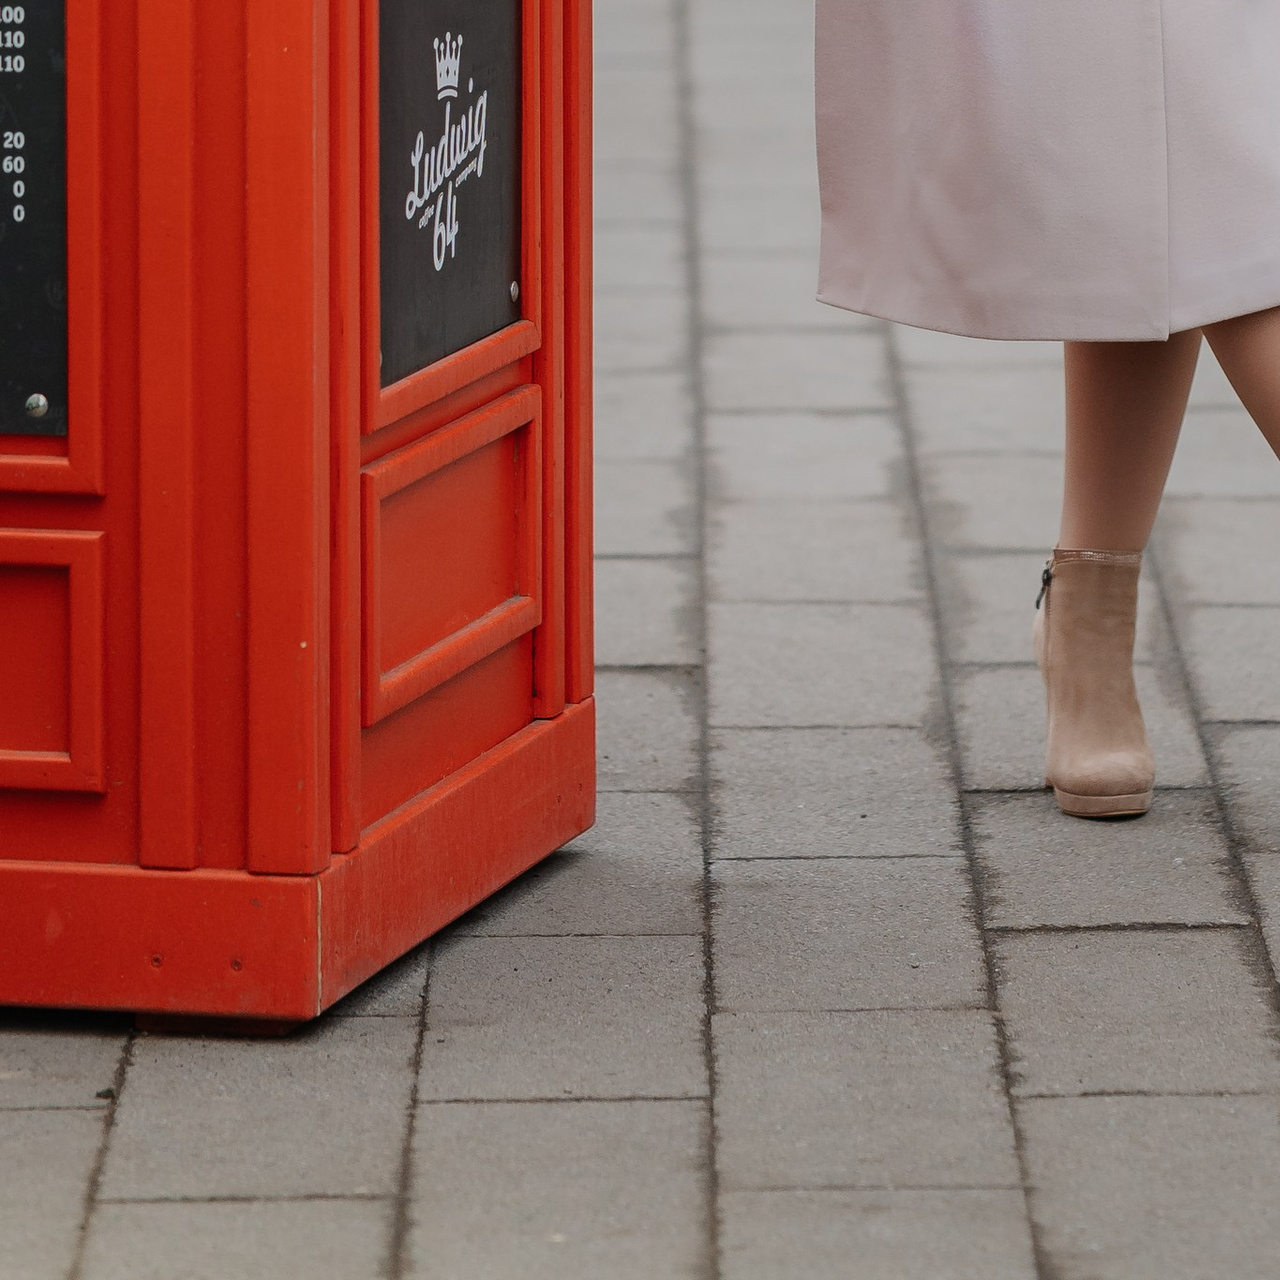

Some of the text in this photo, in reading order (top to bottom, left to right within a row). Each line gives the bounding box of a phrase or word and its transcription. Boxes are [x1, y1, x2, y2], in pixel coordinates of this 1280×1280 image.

[0, 5, 25, 24] 00
[0, 30, 25, 49] 10
[0, 55, 25, 73] 10
[3, 131, 25, 150] 20
[405, 77, 487, 220] Ludwig
[2, 155, 25, 174] 60
[12, 180, 25, 198] 0
[12, 204, 25, 223] 0
[433, 180, 459, 272] 64
